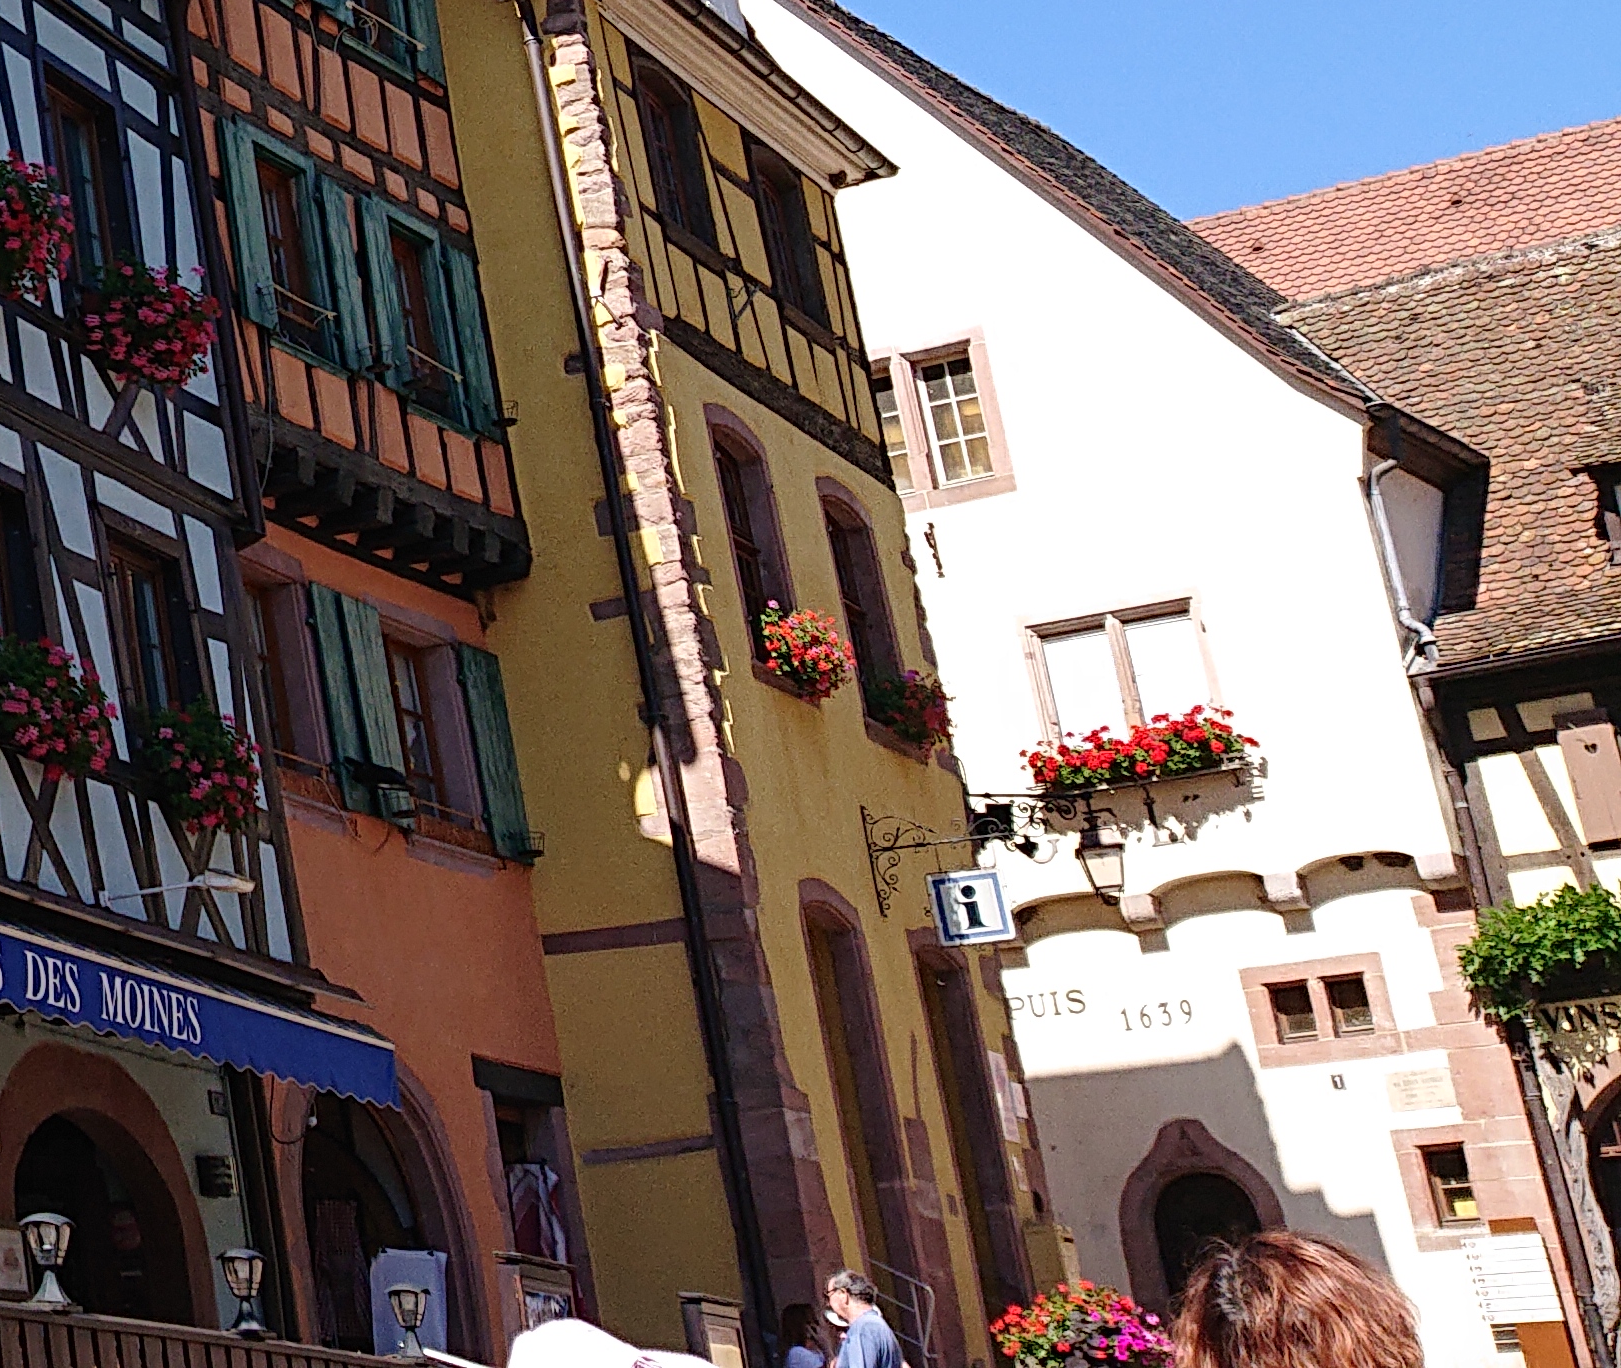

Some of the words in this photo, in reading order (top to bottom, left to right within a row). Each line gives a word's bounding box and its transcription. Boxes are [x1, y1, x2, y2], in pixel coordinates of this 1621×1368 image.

[23, 949, 81, 1014] DES
[99, 971, 202, 1045] MOINES
[1120, 999, 1193, 1031] 1639
